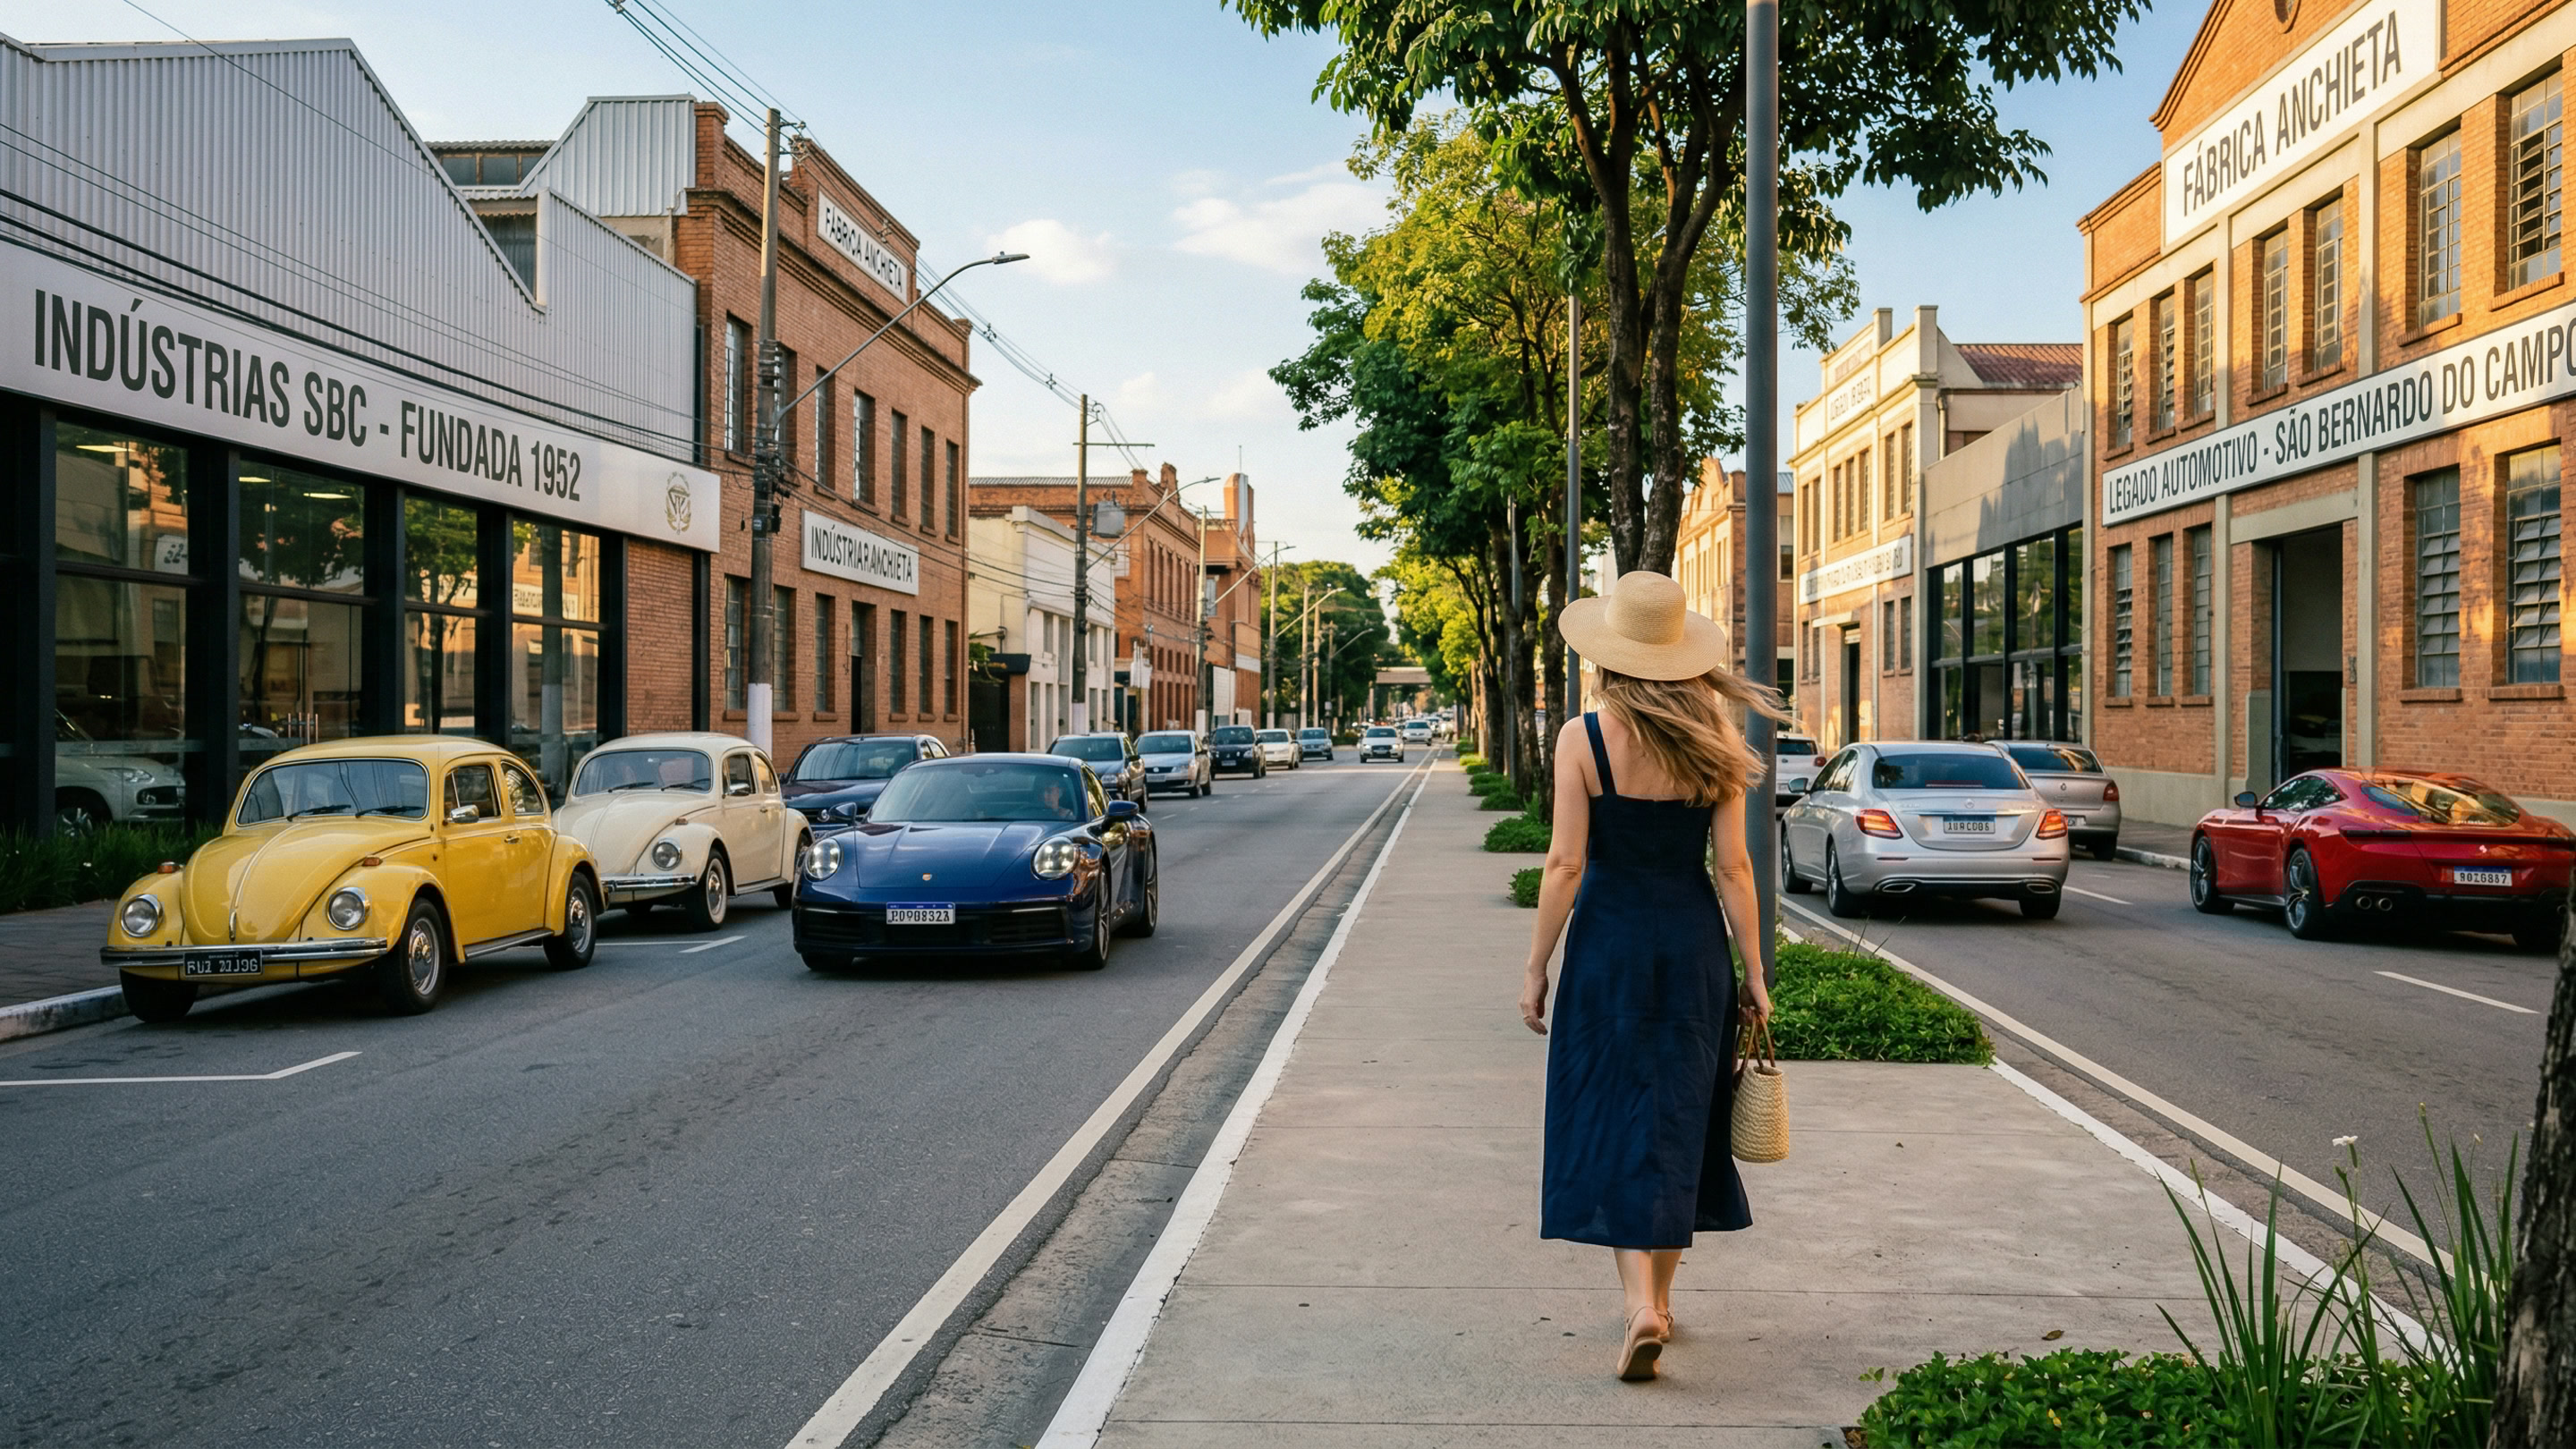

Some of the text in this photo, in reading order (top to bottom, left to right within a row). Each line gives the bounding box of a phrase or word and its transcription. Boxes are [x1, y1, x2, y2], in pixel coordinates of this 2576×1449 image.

[2183, 9, 2402, 217] FÁBRICA ANCHIETA
[34, 288, 581, 503] INDÚSTRIAS SBC - FUNDADA 1952
[2108, 465, 2157, 514] LEGADO
[2161, 430, 2258, 499] AUTOMOTIVO
[2275, 407, 2311, 466] SÃO
[2318, 369, 2434, 453] BERNARDO
[2442, 355, 2476, 416] DO
